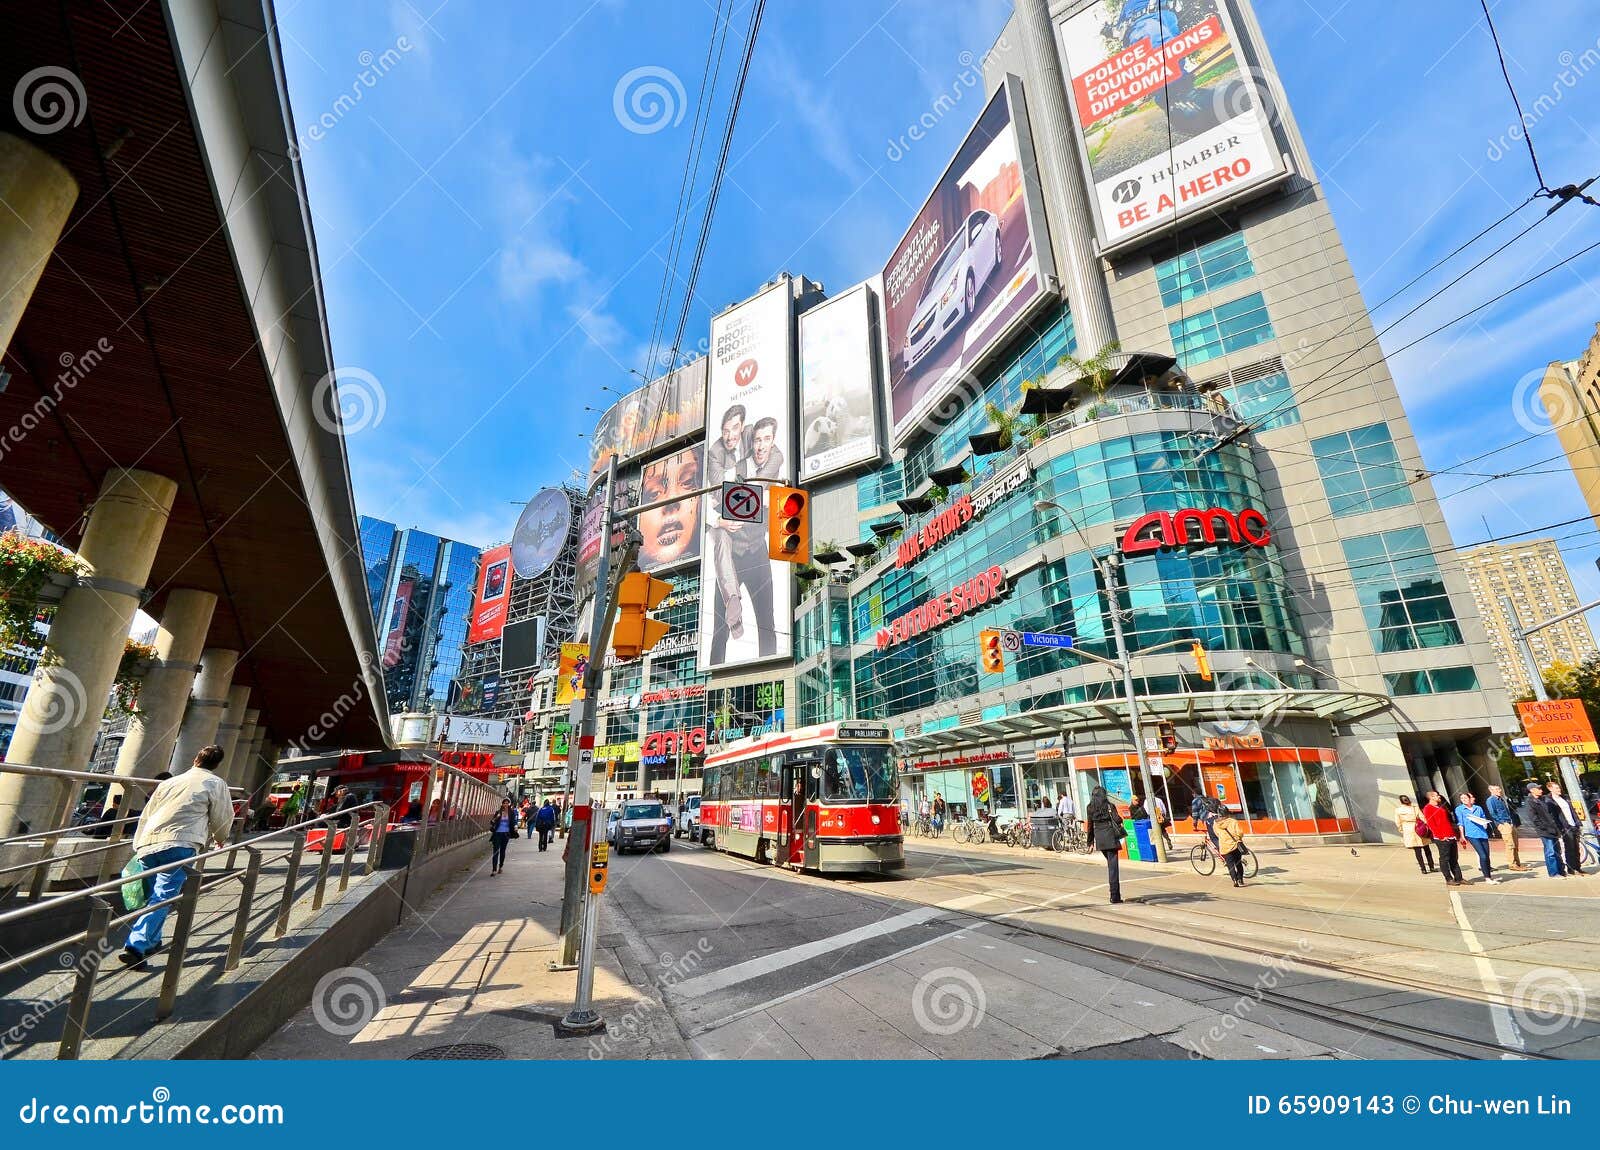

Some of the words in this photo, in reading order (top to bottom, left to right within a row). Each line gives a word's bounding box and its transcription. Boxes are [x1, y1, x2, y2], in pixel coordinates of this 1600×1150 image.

[1084, 44, 1146, 88] POLICE
[1087, 25, 1214, 102] FOUNDATIONS
[1091, 66, 1175, 117] DIPLOMA
[1151, 135, 1241, 185] HUMBER
[1117, 202, 1150, 229] BE
[1157, 193, 1175, 213] A
[1179, 157, 1252, 202] HERO
[891, 591, 950, 646] FUTURE
[951, 565, 1003, 617] SHOP
[655, 637, 679, 653] HARK
[680, 631, 699, 648] CLU
[1031, 634, 1059, 645] Victoria
[757, 683, 783, 698] NOW
[1523, 703, 1561, 712] Victoria
[1565, 701, 1575, 709] St
[1533, 712, 1574, 722] CLOSED
[462, 721, 491, 735] XXI
[1203, 732, 1264, 750] WIND
[1541, 735, 1569, 744] Gould
[1572, 734, 1583, 742] St
[1546, 746, 1561, 754] NO
[1565, 744, 1585, 753] EXIT
